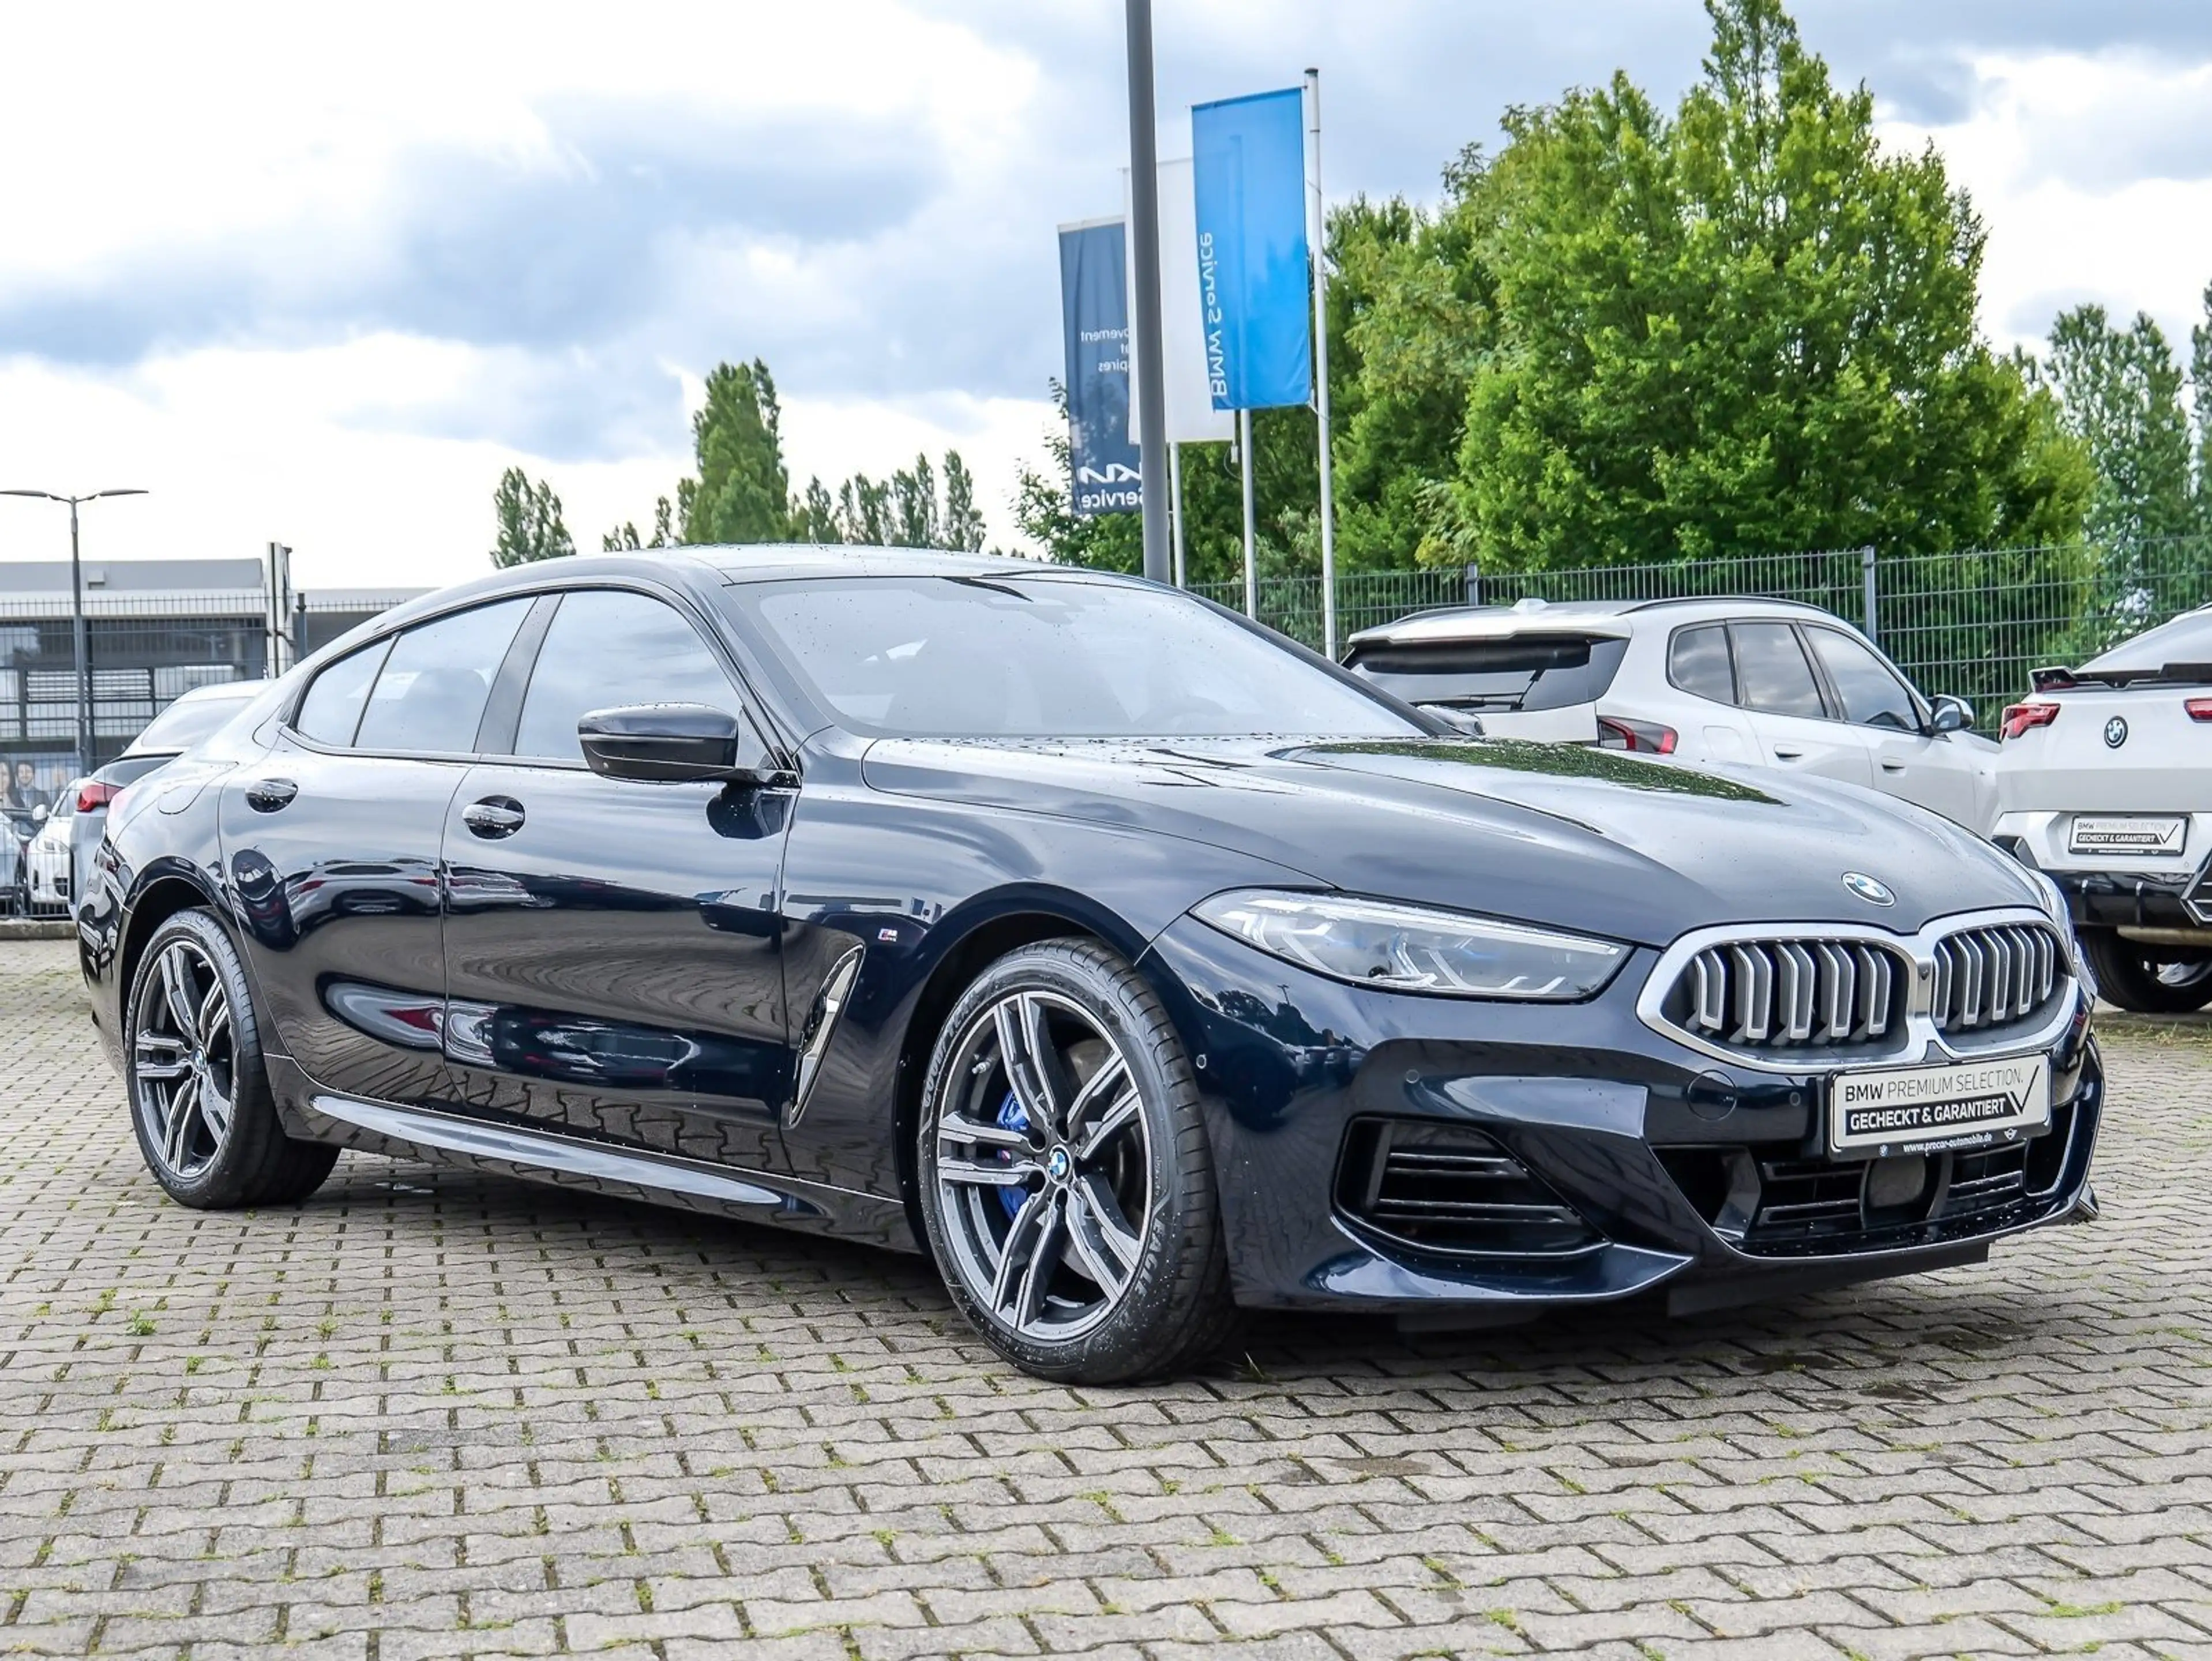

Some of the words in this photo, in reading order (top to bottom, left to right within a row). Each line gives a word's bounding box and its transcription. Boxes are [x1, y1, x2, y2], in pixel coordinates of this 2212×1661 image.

[2078, 822, 2095, 830] BMW
[1845, 1083, 1883, 1102] BMW
[1887, 1076, 1953, 1099] PREMIUM
[1850, 1108, 1920, 1130] GECHECKT
[1921, 1105, 1932, 1123] &
[1934, 1097, 2006, 1122] GARANTIERT
[1135, 1217, 1166, 1297] EAGLE
